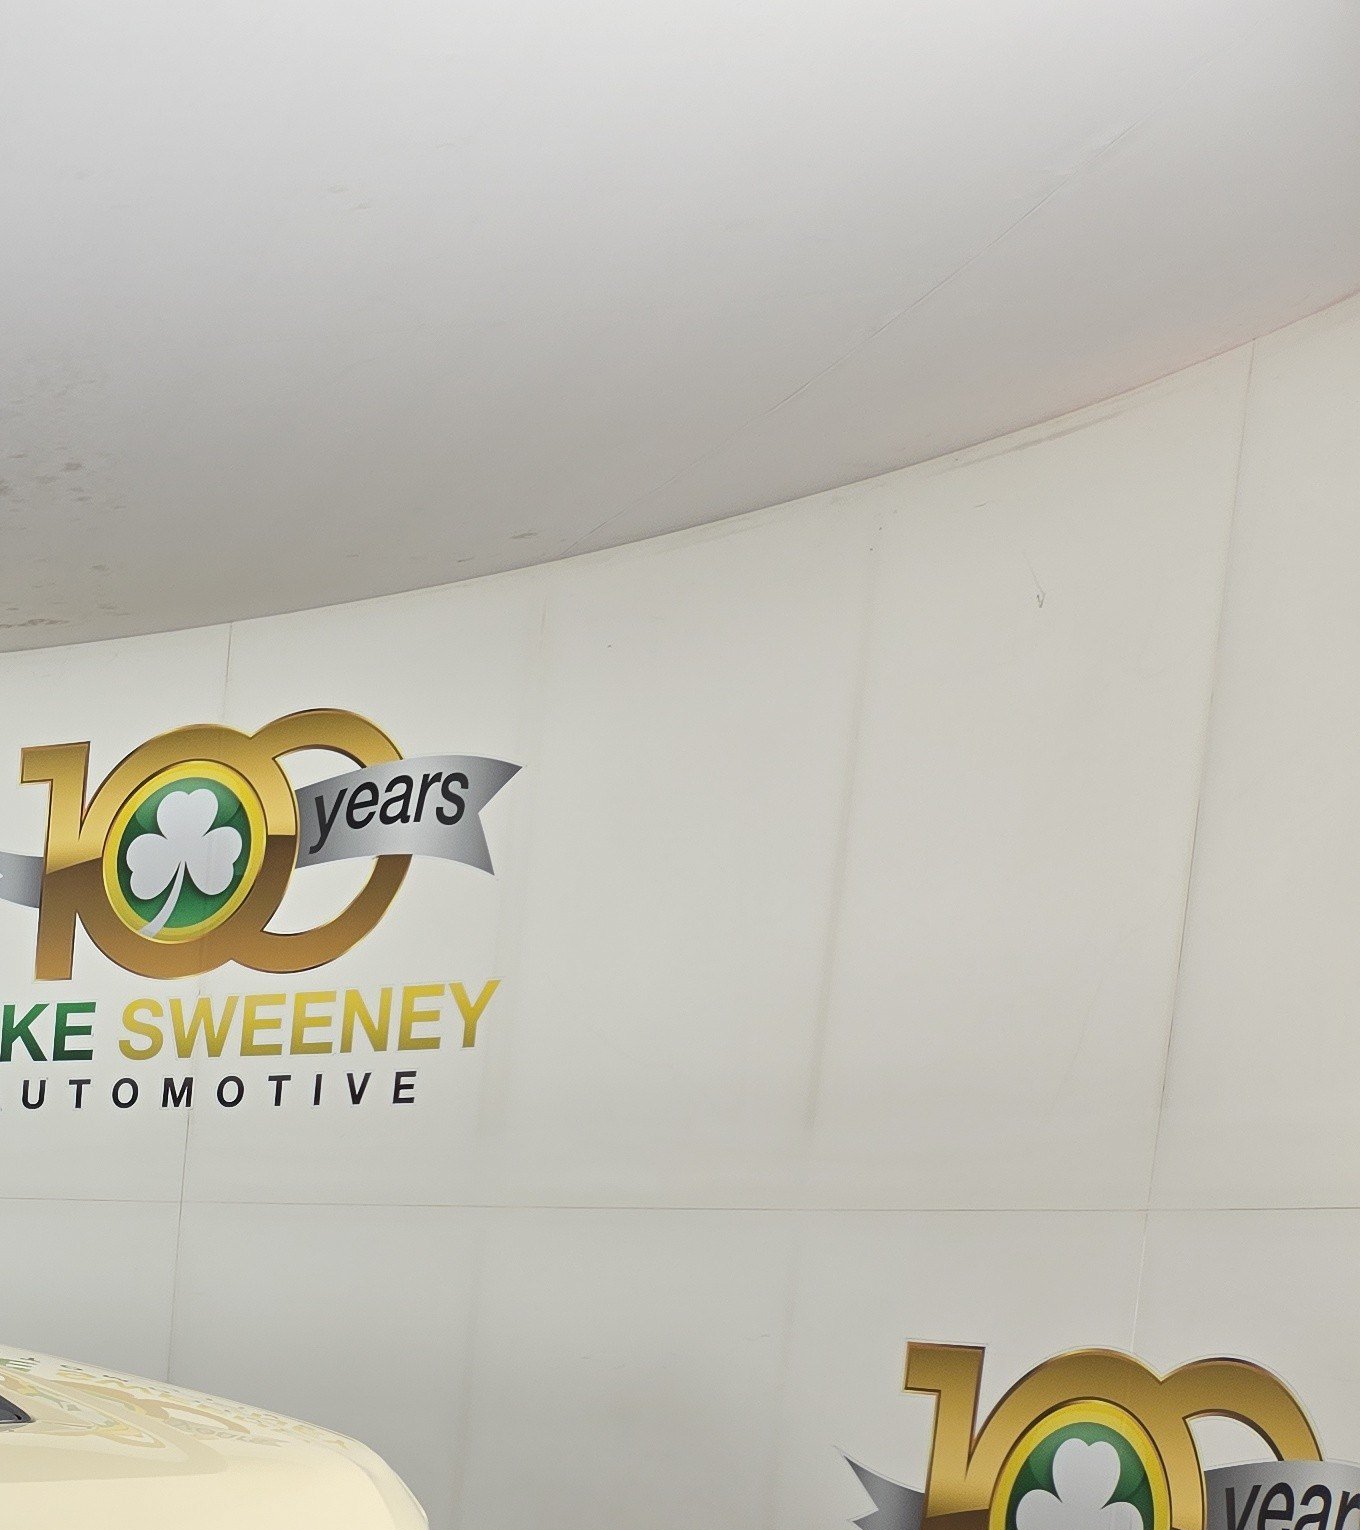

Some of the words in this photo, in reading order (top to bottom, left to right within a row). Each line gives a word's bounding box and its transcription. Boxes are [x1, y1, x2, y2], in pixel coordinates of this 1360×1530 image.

[20, 708, 413, 981] 100
[308, 768, 470, 855] years
[118, 980, 501, 1061] SWEENEY
